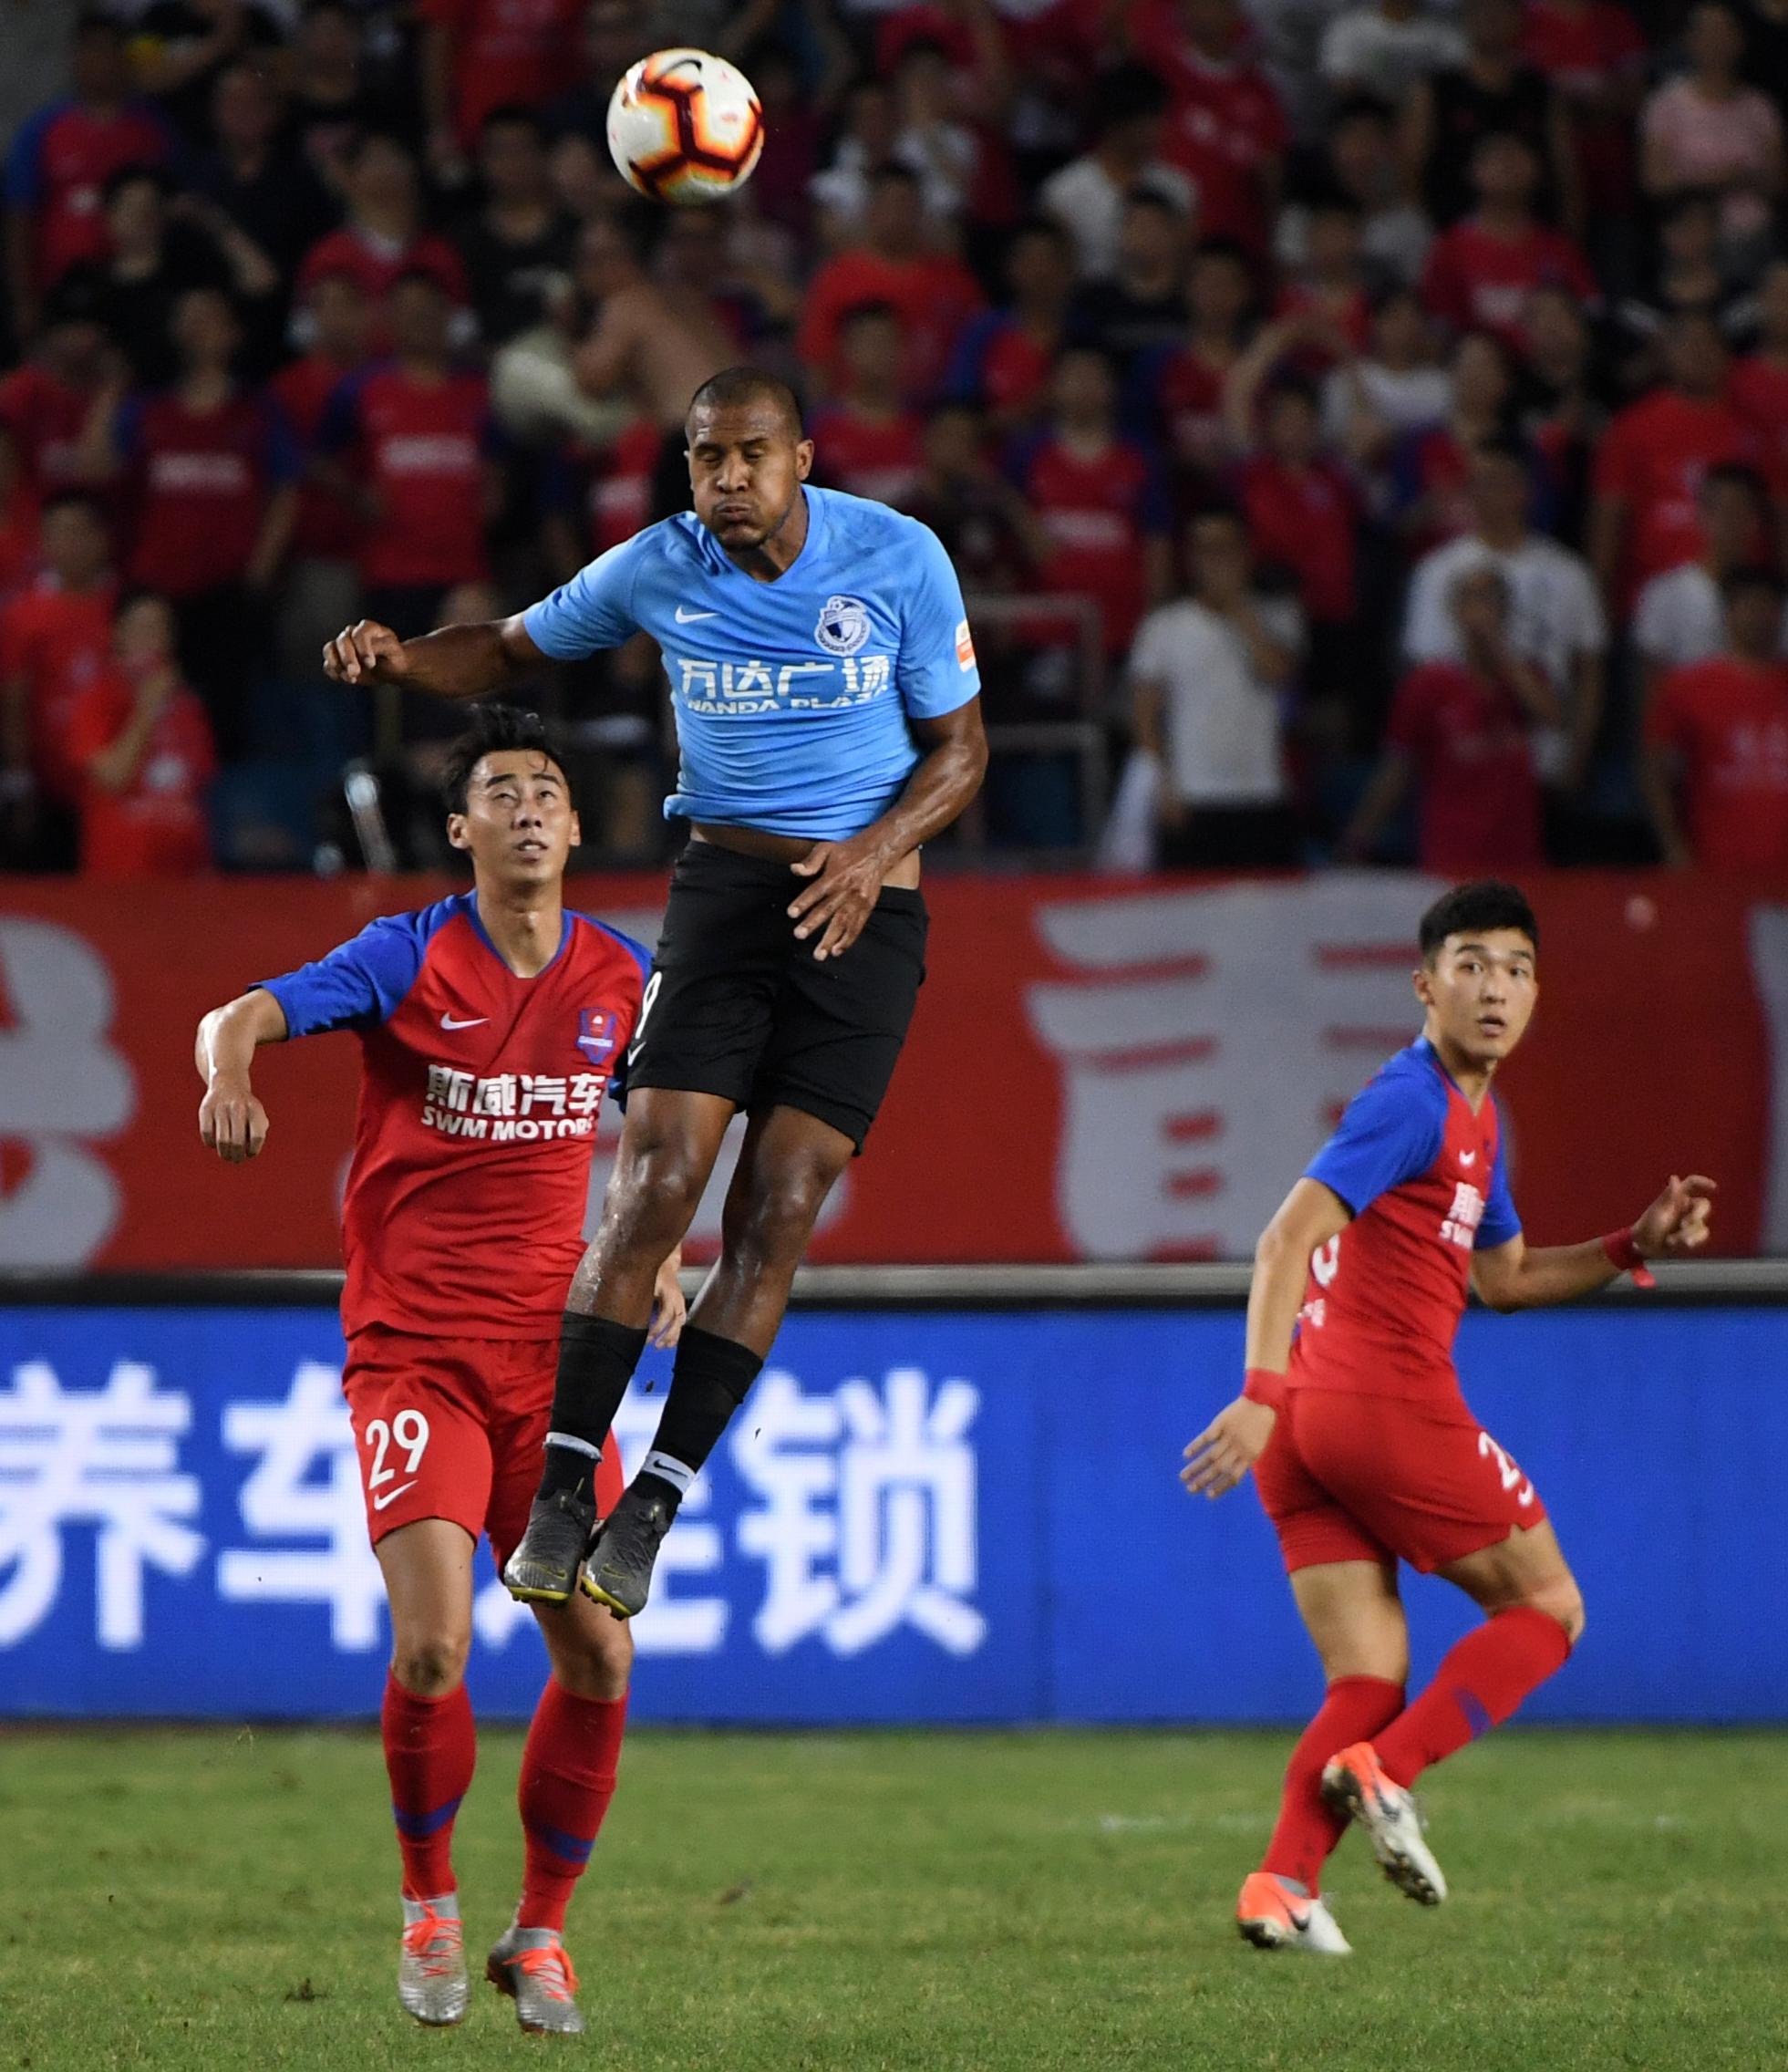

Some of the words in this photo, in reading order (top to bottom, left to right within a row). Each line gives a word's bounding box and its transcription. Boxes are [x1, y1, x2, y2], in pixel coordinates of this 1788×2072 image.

[677, 655, 890, 699] 万达广场
[791, 694, 874, 709] PLAZ
[425, 1063, 606, 1117] 斯威汽车
[421, 1105, 489, 1138] SWM
[366, 1409, 429, 1490] 29
